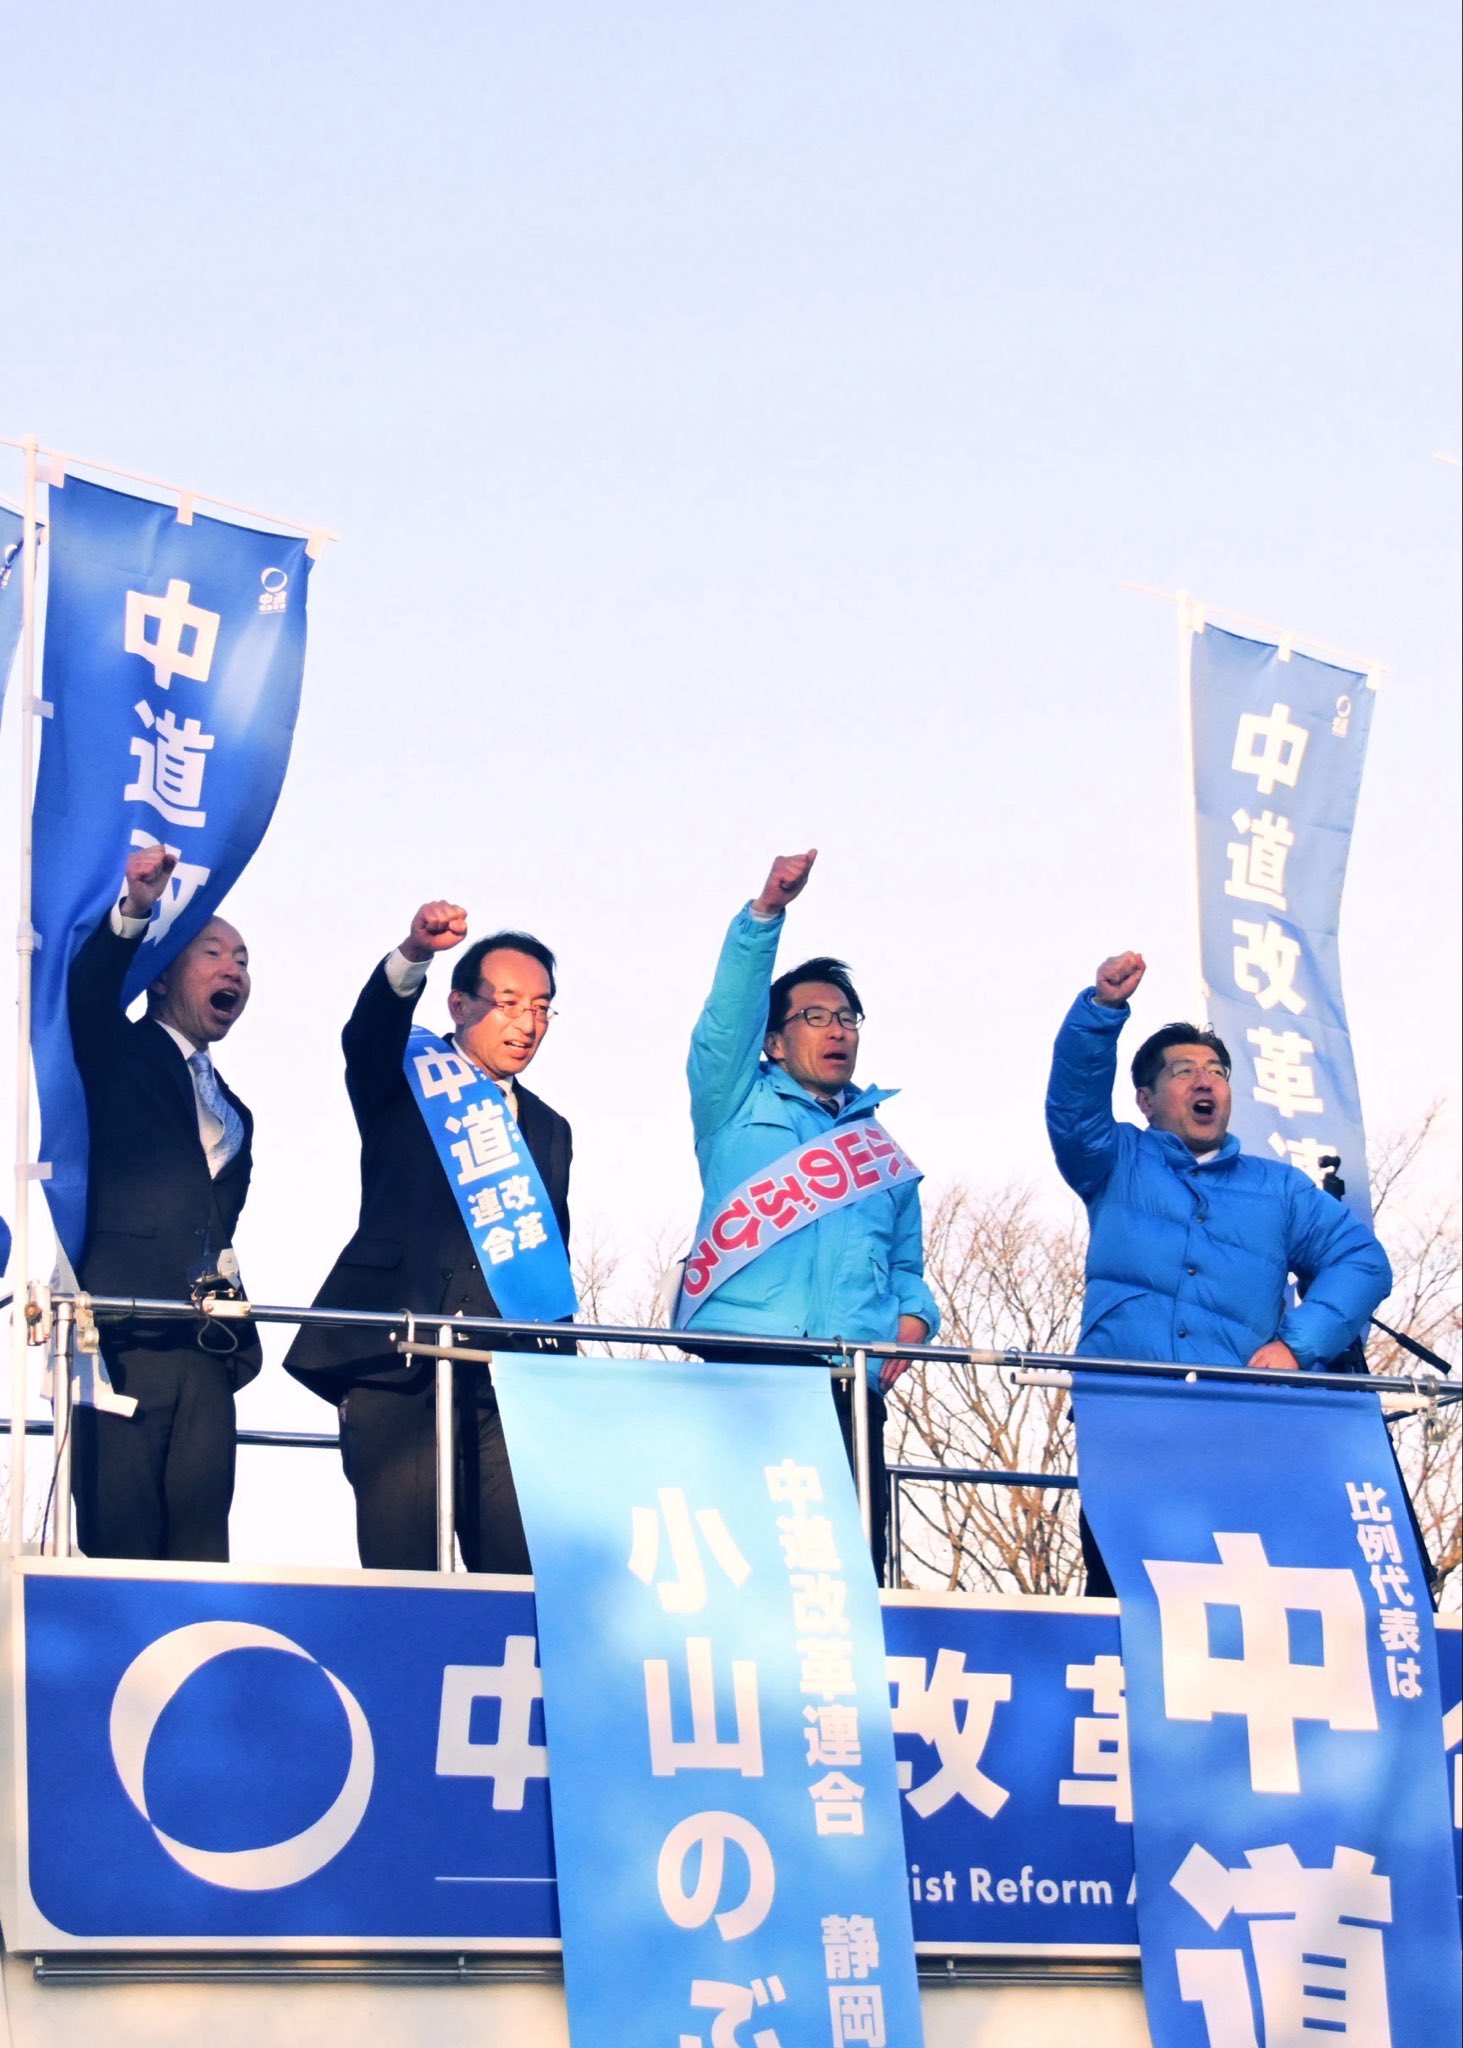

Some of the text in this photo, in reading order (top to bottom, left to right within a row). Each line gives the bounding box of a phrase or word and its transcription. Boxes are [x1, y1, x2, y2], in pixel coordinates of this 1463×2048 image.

[413, 1047, 520, 1185] 中道
[467, 1187, 516, 1265] 連合
[498, 1175, 548, 1250] 改革
[1346, 1482, 1423, 1699] 比例代表は
[435, 1635, 549, 1811] 中
[764, 1458, 886, 2048] 中道改革連合 静岡
[1142, 1532, 1393, 2048] 中道
[907, 1864, 956, 1902] ist
[969, 1866, 1113, 1905] Reform
